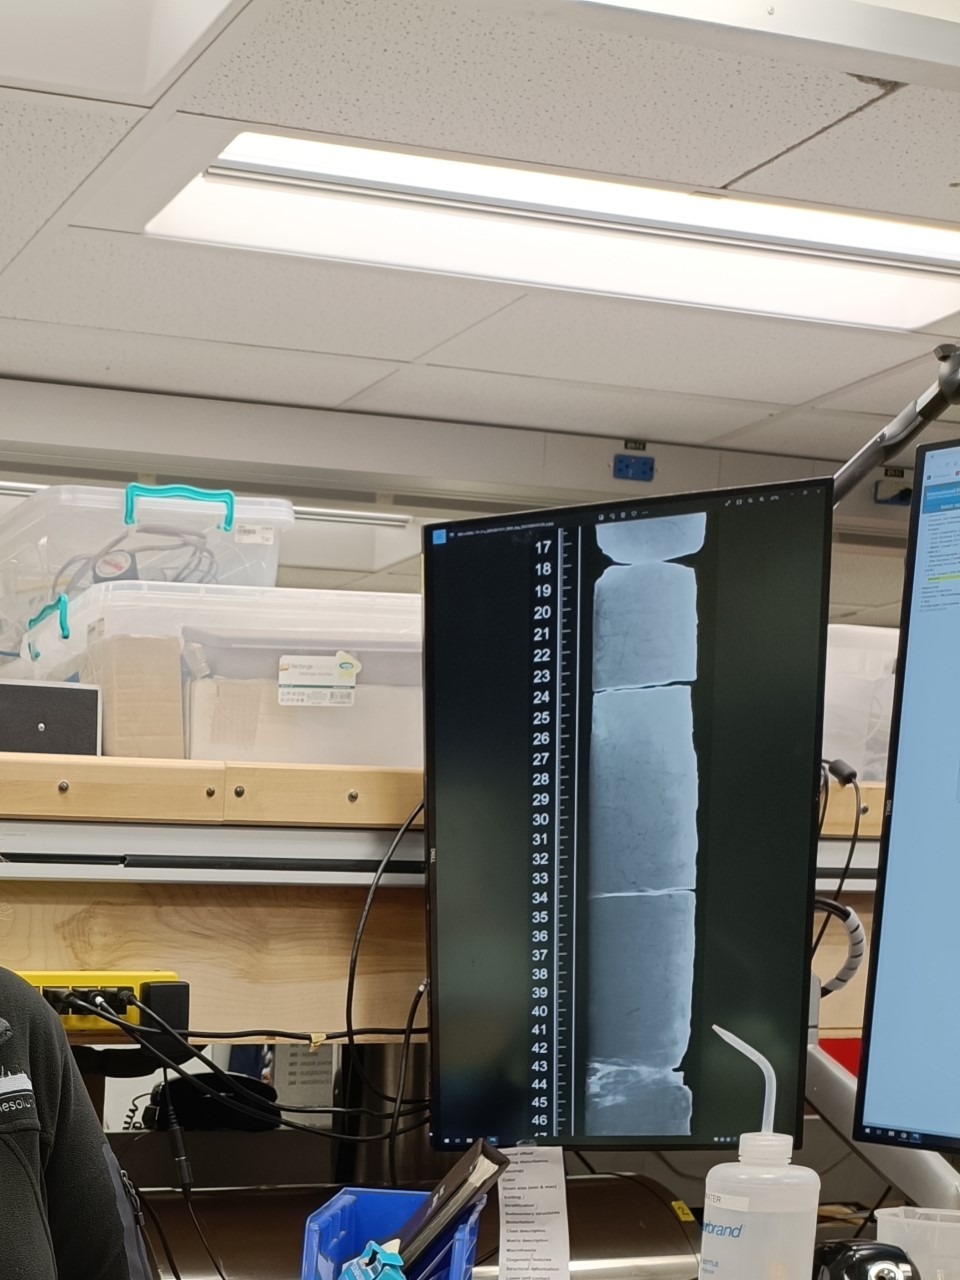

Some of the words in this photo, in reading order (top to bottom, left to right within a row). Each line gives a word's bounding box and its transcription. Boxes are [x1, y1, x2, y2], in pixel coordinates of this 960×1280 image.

[535, 540, 552, 554] 17
[535, 562, 552, 576] 18
[535, 583, 552, 597] 19
[534, 605, 551, 620] 20
[533, 627, 549, 641] 21
[533, 648, 551, 662] 22
[533, 669, 551, 683] 23
[533, 690, 550, 704] 24
[533, 711, 550, 725] 25
[533, 731, 550, 746] 26
[532, 752, 550, 766] 27
[532, 772, 550, 786] 28
[532, 792, 550, 806] 29
[532, 812, 549, 826] 30
[532, 832, 547, 846] 31
[532, 852, 549, 865] 32
[532, 872, 549, 885] 33
[532, 891, 548, 904] 34
[532, 910, 549, 924] 35
[532, 930, 548, 942] 36
[532, 949, 548, 961] 37
[532, 967, 548, 980] 38
[532, 986, 548, 999] 39
[531, 1005, 548, 1017] 40
[531, 1023, 546, 1035] 41
[531, 1042, 548, 1054] 42
[531, 1060, 548, 1072] 43
[531, 1078, 547, 1090] 44
[531, 1096, 548, 1108] 45
[531, 1114, 548, 1126] 46
